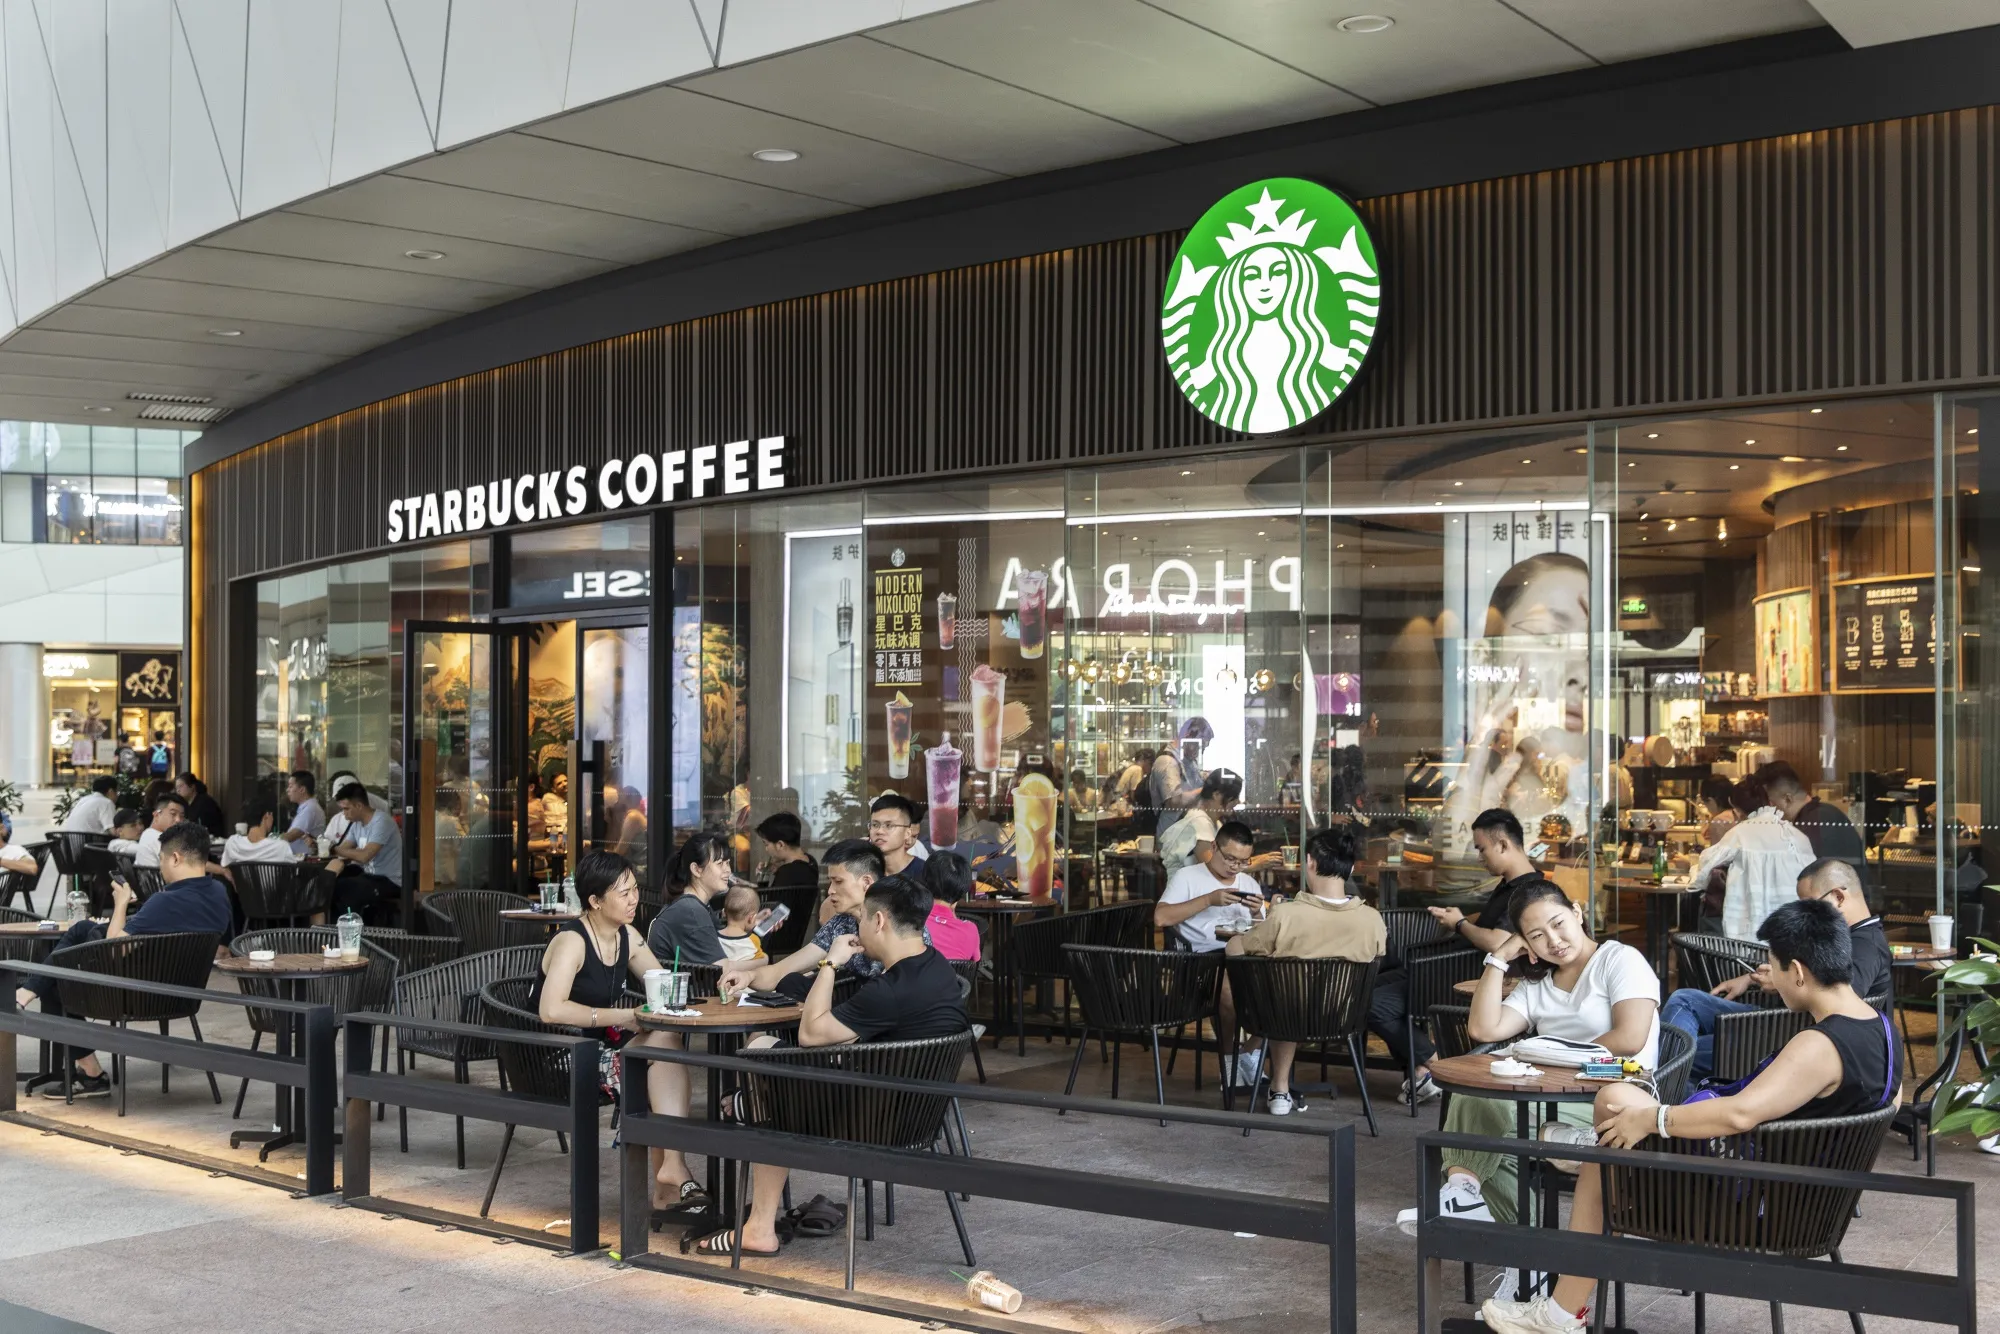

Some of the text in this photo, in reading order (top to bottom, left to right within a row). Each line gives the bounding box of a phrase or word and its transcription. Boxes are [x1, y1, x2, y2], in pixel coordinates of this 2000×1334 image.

[388, 435, 785, 543] STARBUCKS COFFEE
[875, 574, 922, 595] MODERN
[875, 594, 922, 614] MIXOLOGY
[875, 613, 922, 632] 星巴克
[875, 632, 921, 649] 玩味冰调
